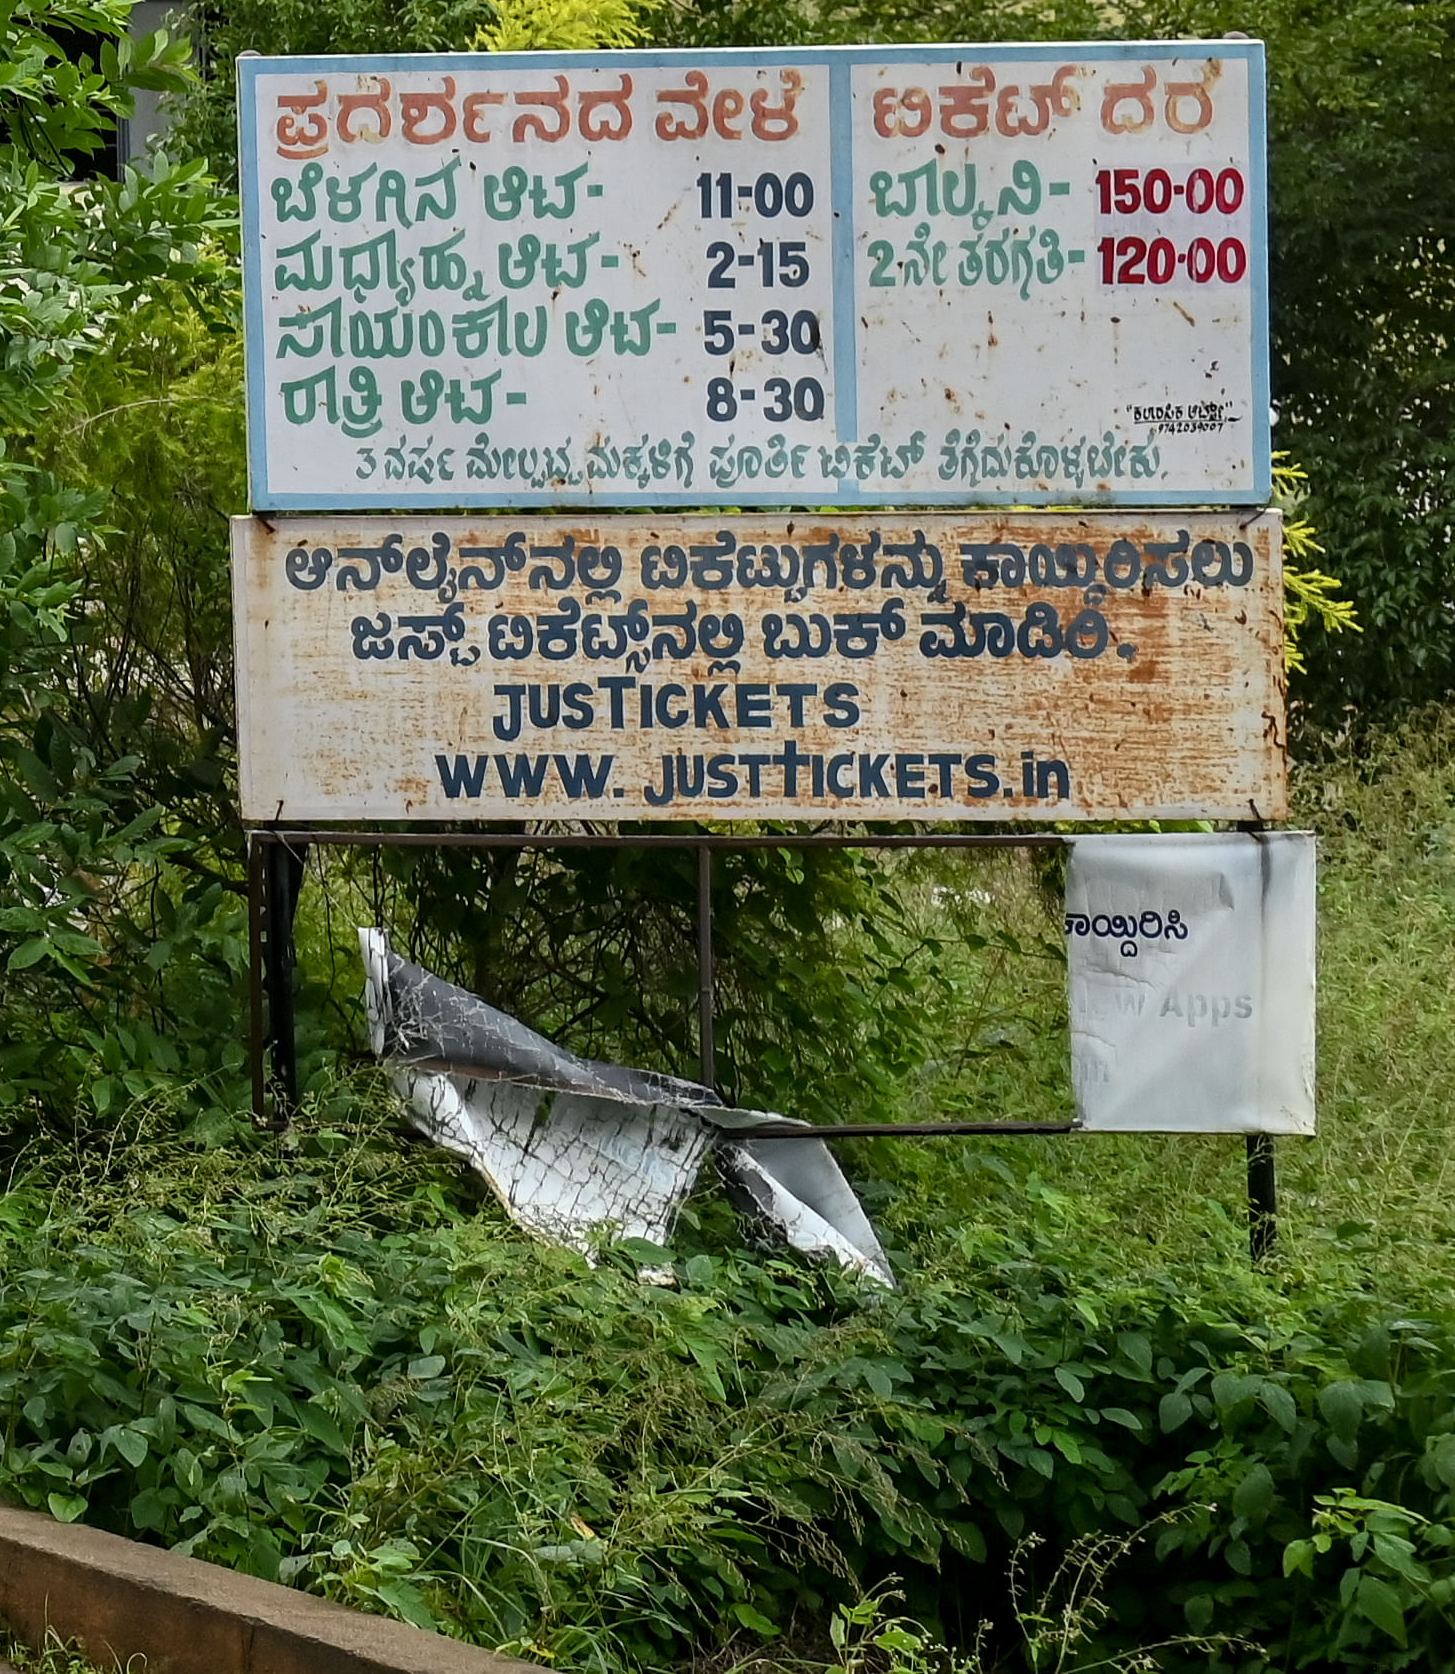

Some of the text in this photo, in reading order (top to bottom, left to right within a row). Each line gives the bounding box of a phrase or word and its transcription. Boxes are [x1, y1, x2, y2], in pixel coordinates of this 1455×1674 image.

[275, 68, 804, 160] ಪ್ರದರ್ಶನದ ವೇಳೆ
[872, 58, 1223, 138] ಟಿಕೆಟ್ ದರ
[270, 155, 462, 230] ಬೆಳಗಿನ
[696, 171, 814, 219] 11-00
[1095, 167, 1246, 216] 150-00
[274, 229, 489, 307] ಮಧ್ಯಾಹ್ನ
[705, 241, 810, 289] 2-15
[1097, 235, 1247, 285] 120-00
[275, 295, 548, 359] ಸಾಯಂಕಾಲ
[704, 309, 821, 357] 5-30
[280, 364, 384, 438] ರಾತ್ರಿ
[705, 376, 826, 423] 8-30
[356, 446, 378, 480] 3
[384, 434, 456, 484] ವರ್ಷ
[586, 429, 696, 489] ಮಕ್ಕಳಿಗೆ
[709, 433, 812, 488] ಪೂರ್ತಿ
[818, 430, 926, 480] ಟಿಕೆಟ್
[639, 530, 950, 605] ಟಿಕೆಟ್ಟುಗಳನ್ನು
[959, 529, 1254, 606] ಕಾಯ್ದಿರಿಸಲು
[350, 599, 481, 667] ಜಸ್ಟ್
[760, 597, 906, 660] ಬುಕ್
[492, 676, 861, 742] JUSTICKETS
[1159, 990, 1253, 1028] Apps
